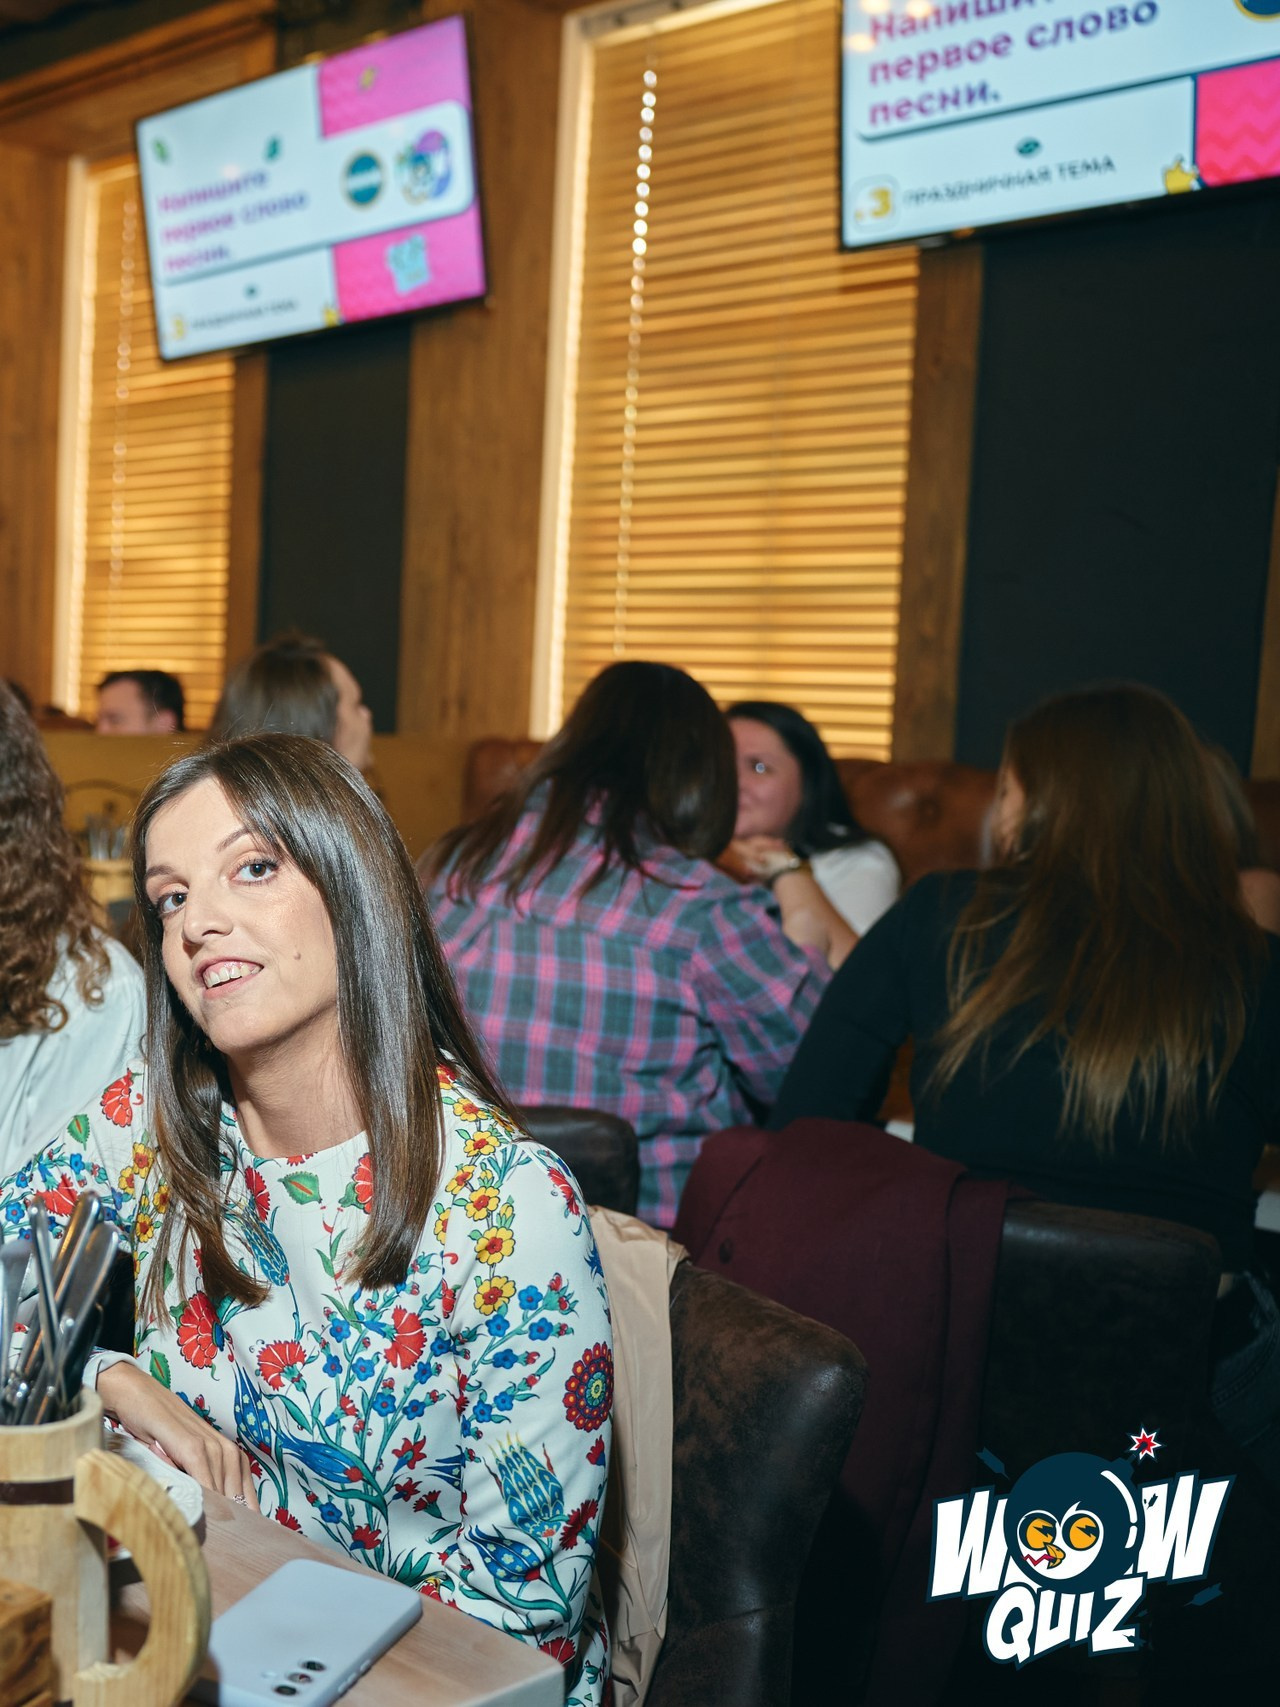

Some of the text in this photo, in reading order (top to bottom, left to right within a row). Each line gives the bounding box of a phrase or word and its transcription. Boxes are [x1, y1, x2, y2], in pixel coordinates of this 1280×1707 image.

[869, 0, 1160, 86] первое слово
[869, 80, 1001, 126] песни.
[1058, 156, 1117, 179] ТЕМА
